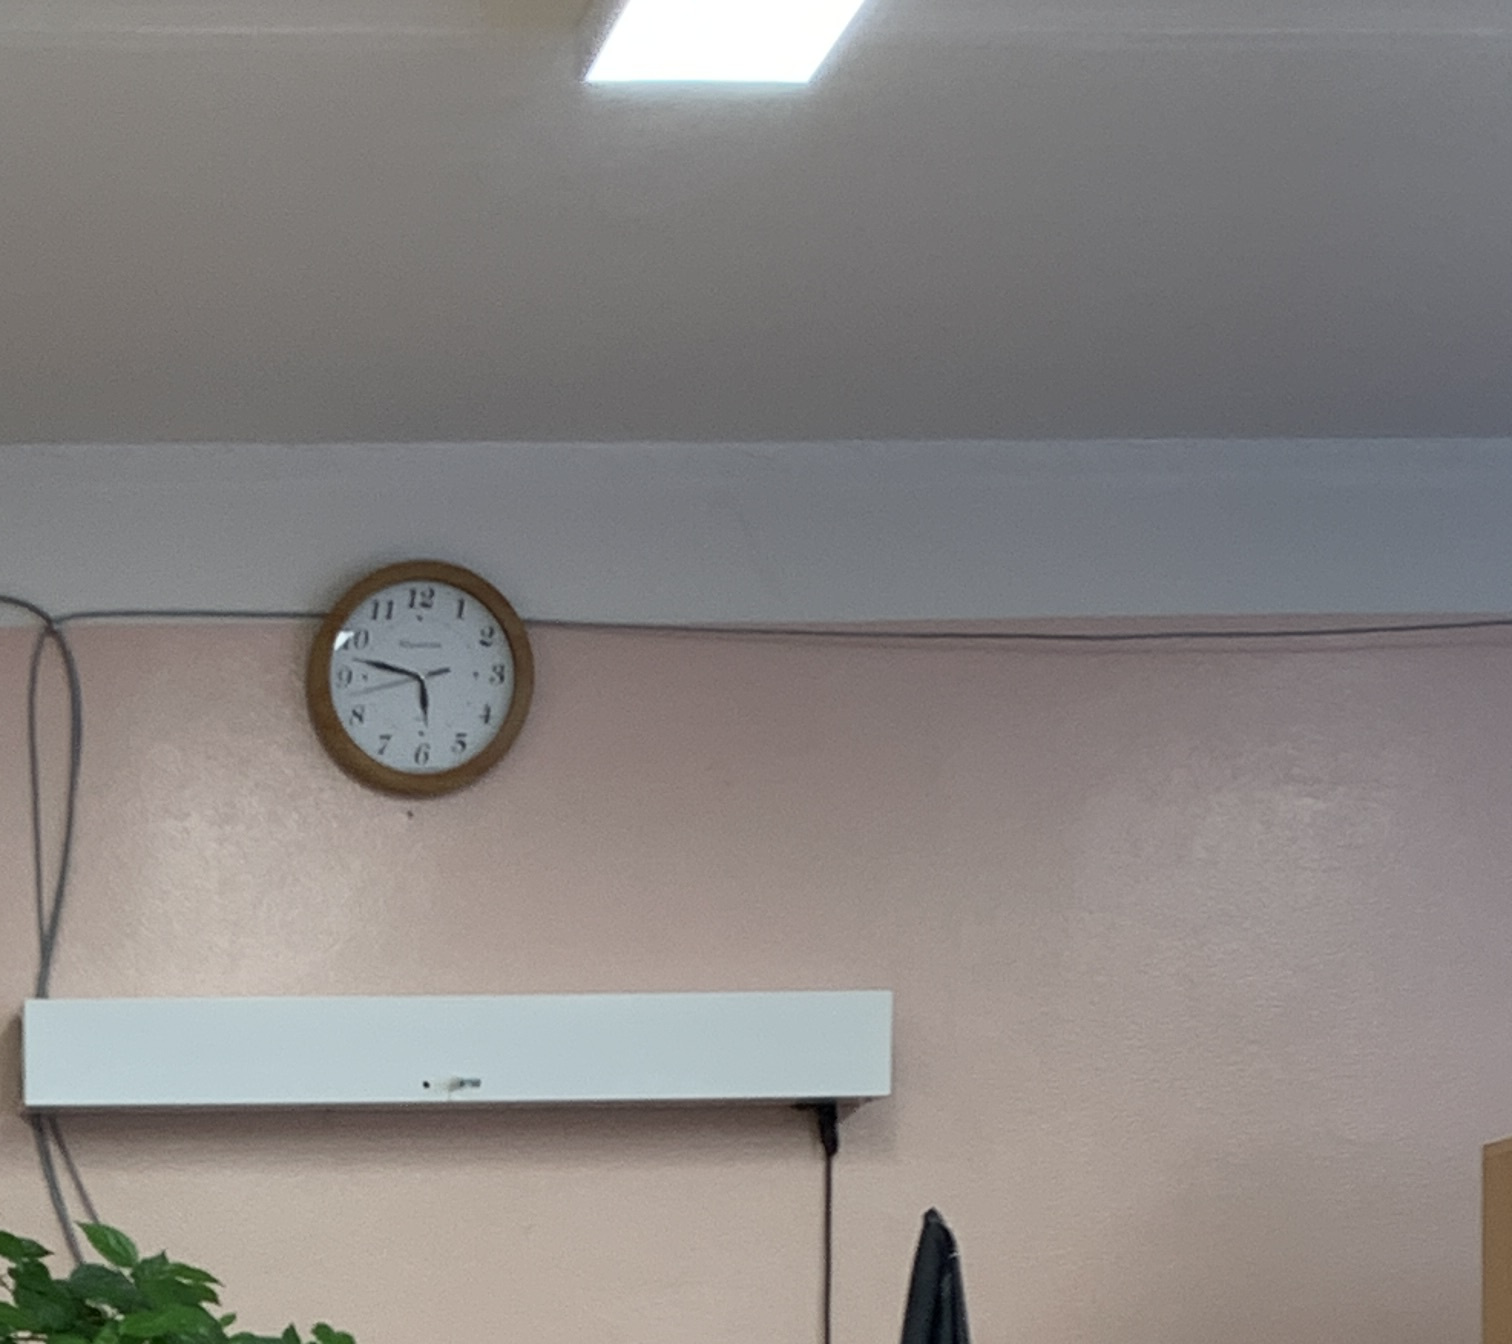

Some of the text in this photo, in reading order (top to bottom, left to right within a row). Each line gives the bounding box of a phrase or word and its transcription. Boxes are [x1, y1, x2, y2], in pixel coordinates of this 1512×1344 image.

[408, 587, 435, 609] 12
[455, 597, 466, 620] 1
[370, 599, 394, 621] 11
[479, 626, 495, 648] 2
[335, 667, 353, 688] 9
[489, 664, 505, 685] 3
[348, 705, 365, 725] 8
[479, 703, 492, 724] 4
[377, 734, 392, 755] 7
[414, 742, 430, 765] 6
[450, 733, 467, 753] 5
